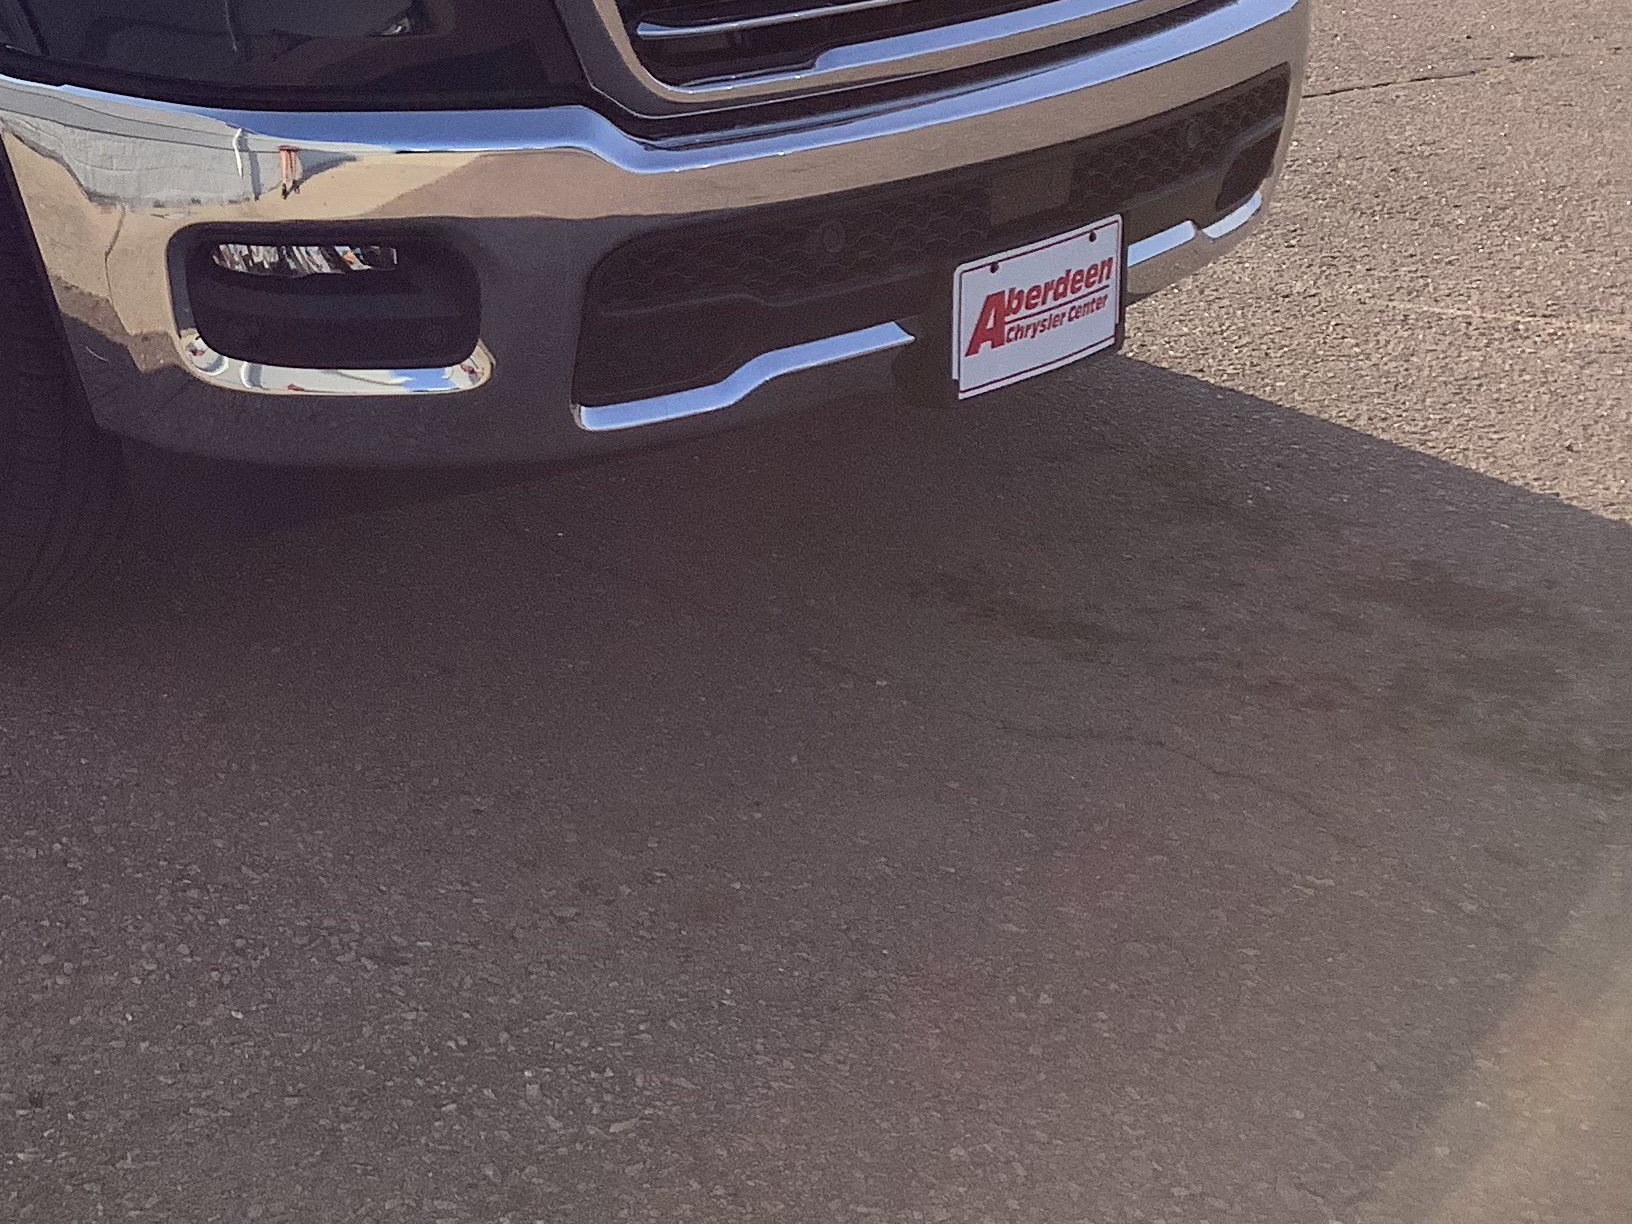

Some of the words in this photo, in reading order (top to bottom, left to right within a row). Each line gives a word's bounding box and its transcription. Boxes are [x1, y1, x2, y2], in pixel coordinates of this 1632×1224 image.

[965, 256, 1114, 357] Aberdeen
[1006, 311, 1067, 344] Chrysler
[1067, 293, 1109, 323] Center
